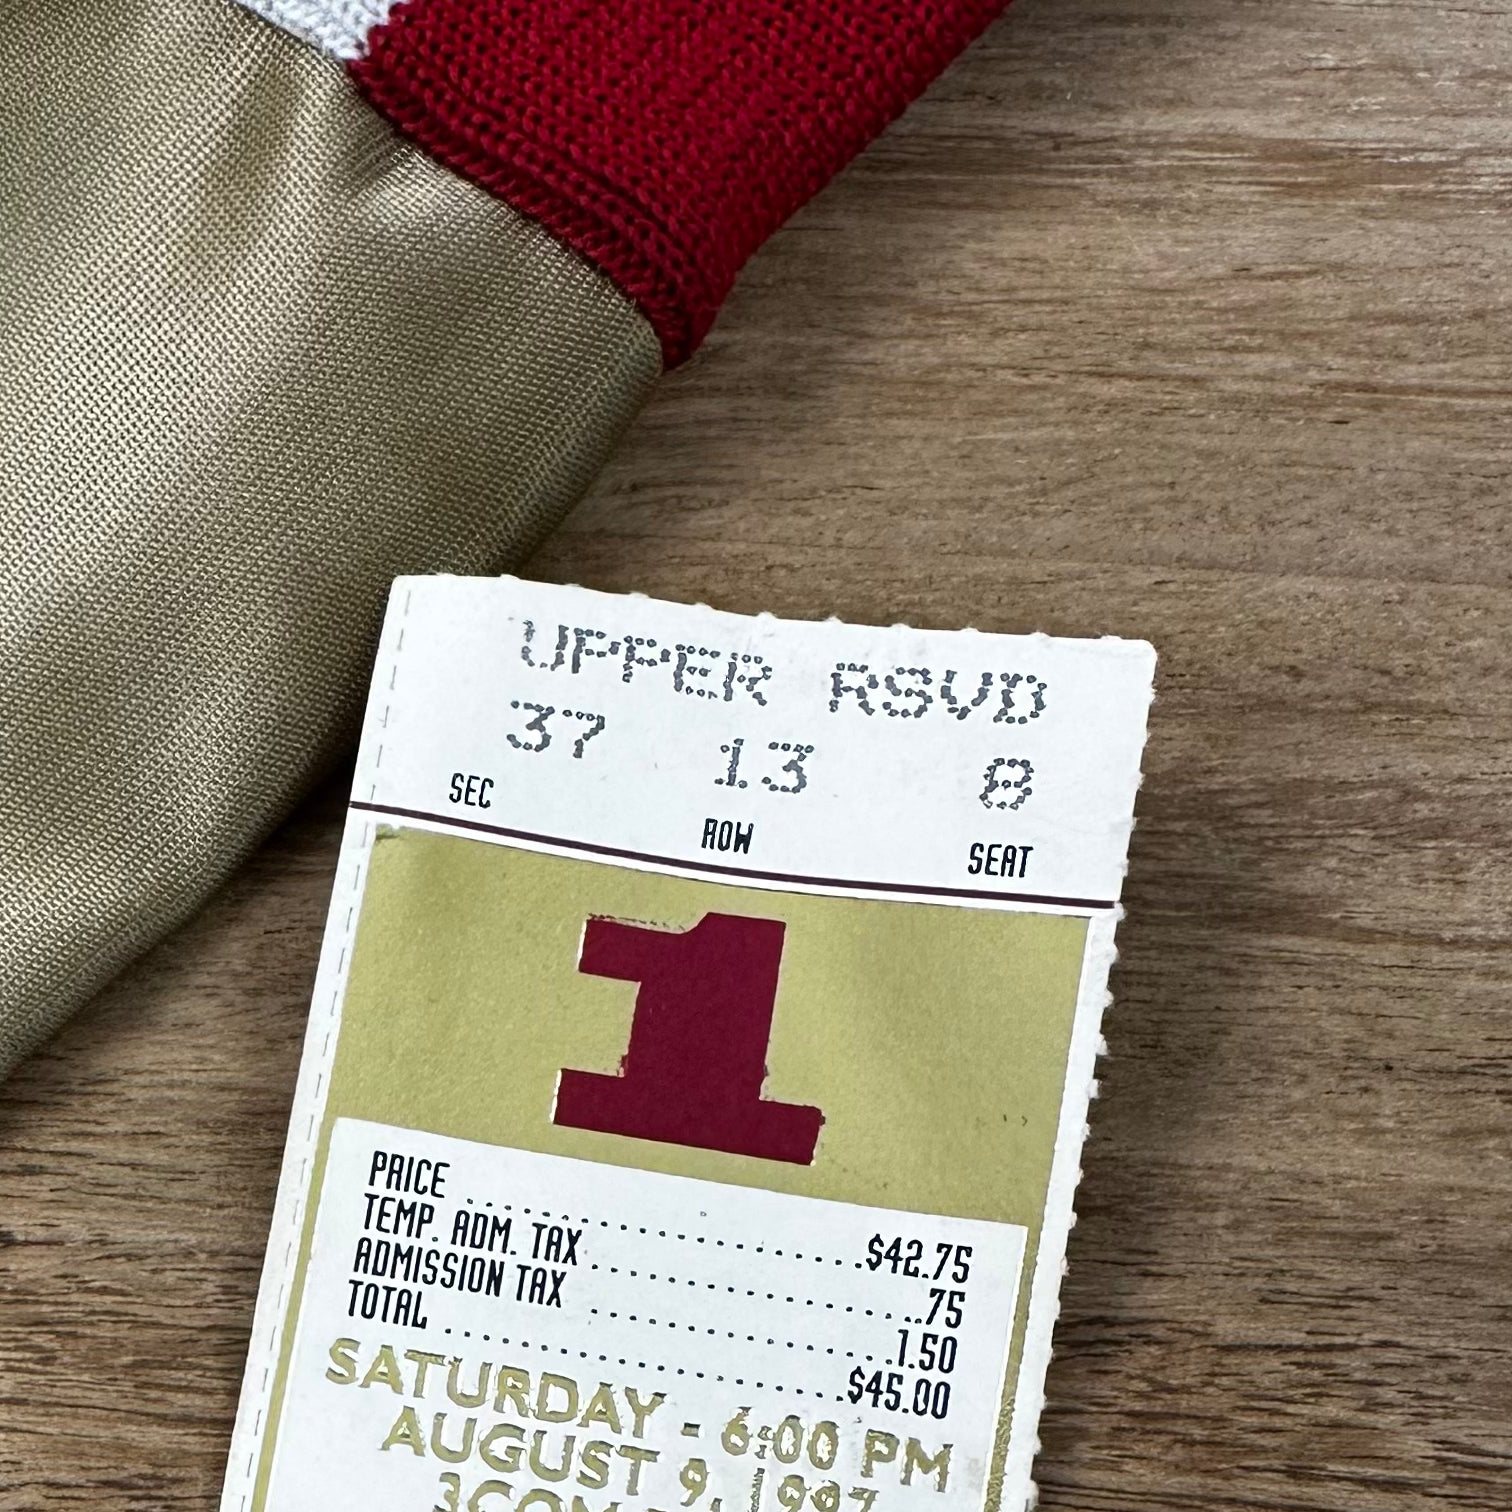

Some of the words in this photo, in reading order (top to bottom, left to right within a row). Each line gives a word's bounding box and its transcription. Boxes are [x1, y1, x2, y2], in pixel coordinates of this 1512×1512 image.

[522, 620, 772, 706] UPPER
[829, 663, 1047, 724] RSVD
[507, 701, 605, 758] 37
[715, 739, 814, 794] 13
[979, 758, 1034, 810] 8
[449, 773, 494, 808] SEC
[702, 818, 754, 854] ROW
[968, 843, 1033, 878] SEAT
[555, 913, 822, 1164] 1
[364, 1193, 438, 1242] TEMP.
[451, 1210, 516, 1255] ADM.
[532, 1223, 582, 1265] TAX
[369, 1151, 450, 1198] PRICE
[866, 1234, 972, 1283] $42.75
[349, 1280, 427, 1329] TOTAL
[848, 1366, 950, 1419] $45.00
[354, 1237, 504, 1297] ADMISSION
[517, 1264, 566, 1308] TAX
[898, 1329, 957, 1373] 1.50
[326, 1338, 666, 1438] SATURDAY
[721, 1406, 840, 1470] 6:00
[863, 1430, 953, 1492] PM
[382, 1406, 661, 1496] AUGUST
